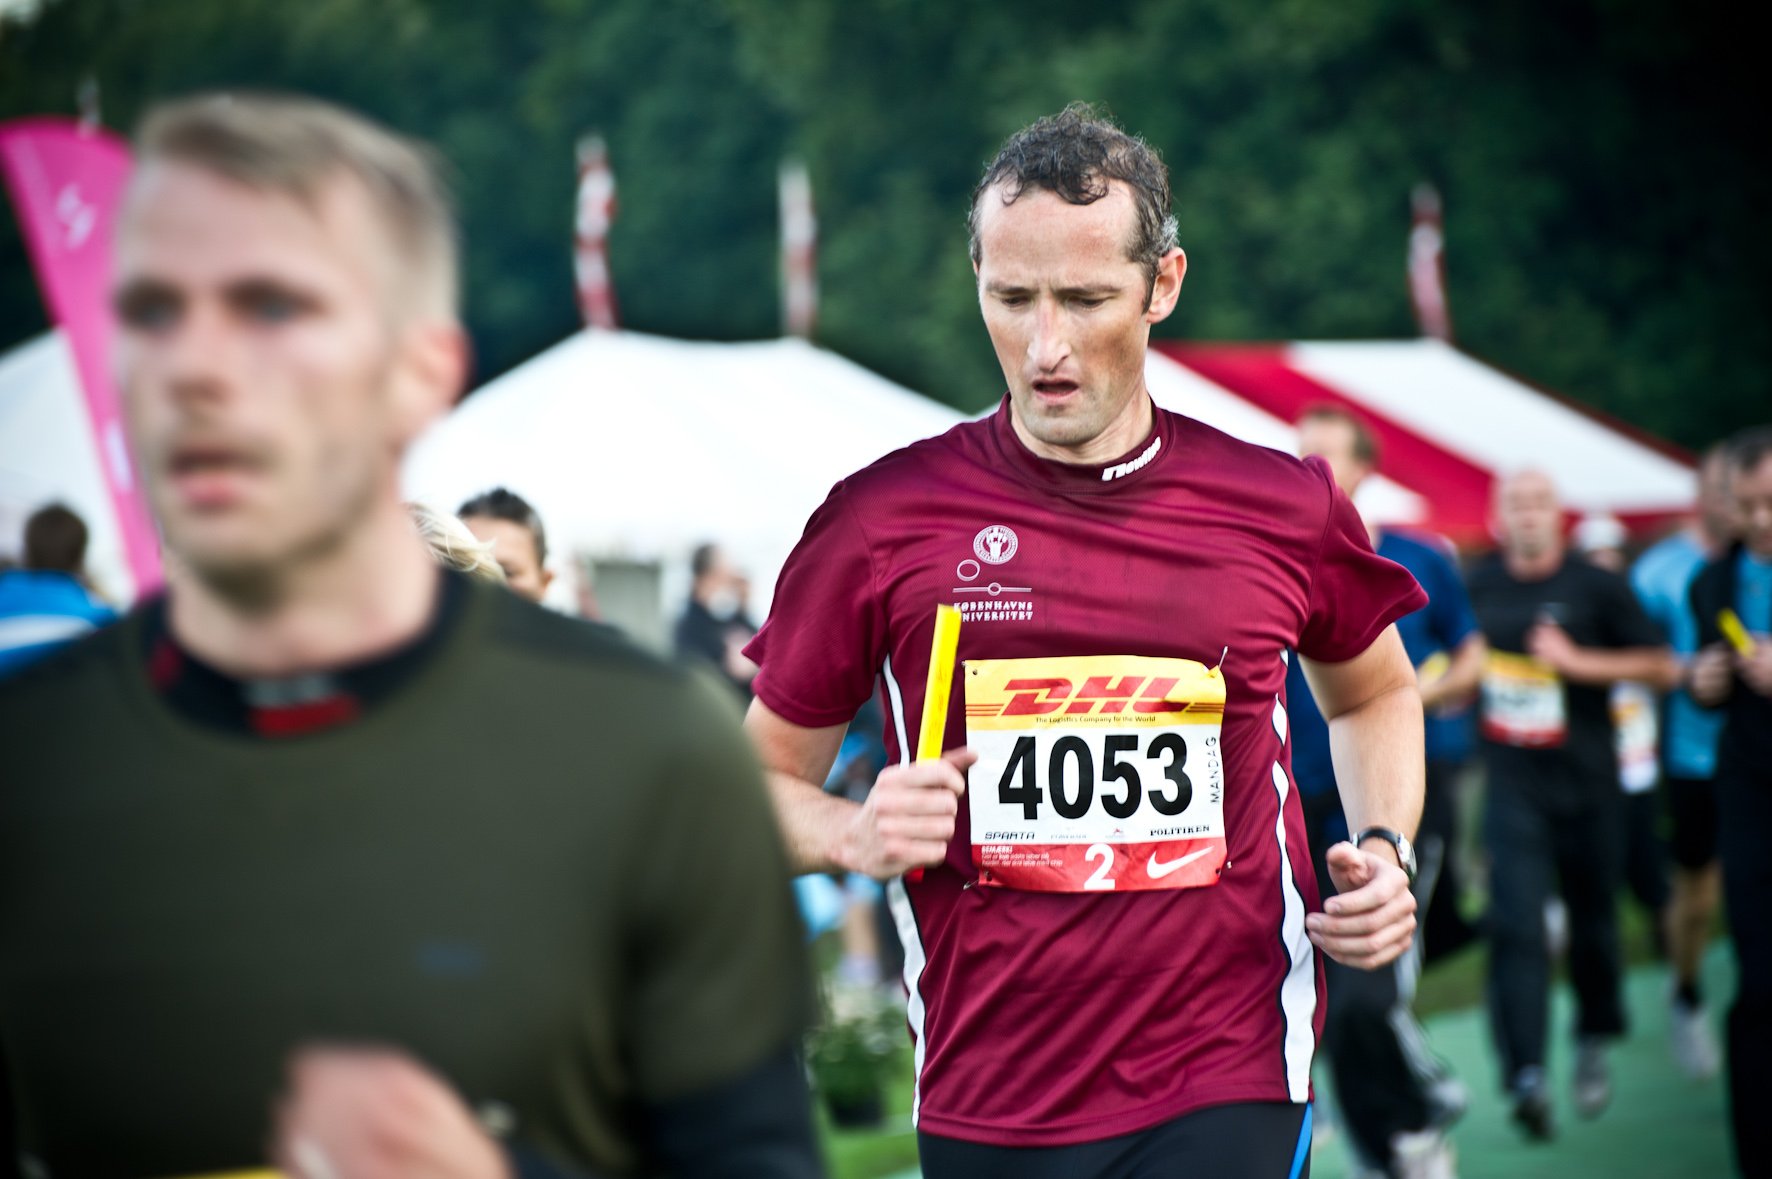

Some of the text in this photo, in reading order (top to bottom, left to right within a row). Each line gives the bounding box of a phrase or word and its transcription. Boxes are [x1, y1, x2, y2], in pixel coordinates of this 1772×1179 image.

[953, 601, 1033, 612] KØBENHAVNS
[962, 611, 1034, 622] NIVERSITET
[1001, 676, 1192, 715] DHL
[998, 732, 1193, 820] 4053
[1205, 736, 1220, 804] MANDAG
[984, 831, 1035, 840] SPARTA
[1150, 825, 1210, 836] POLITIKEN
[1084, 842, 1115, 890] 2
